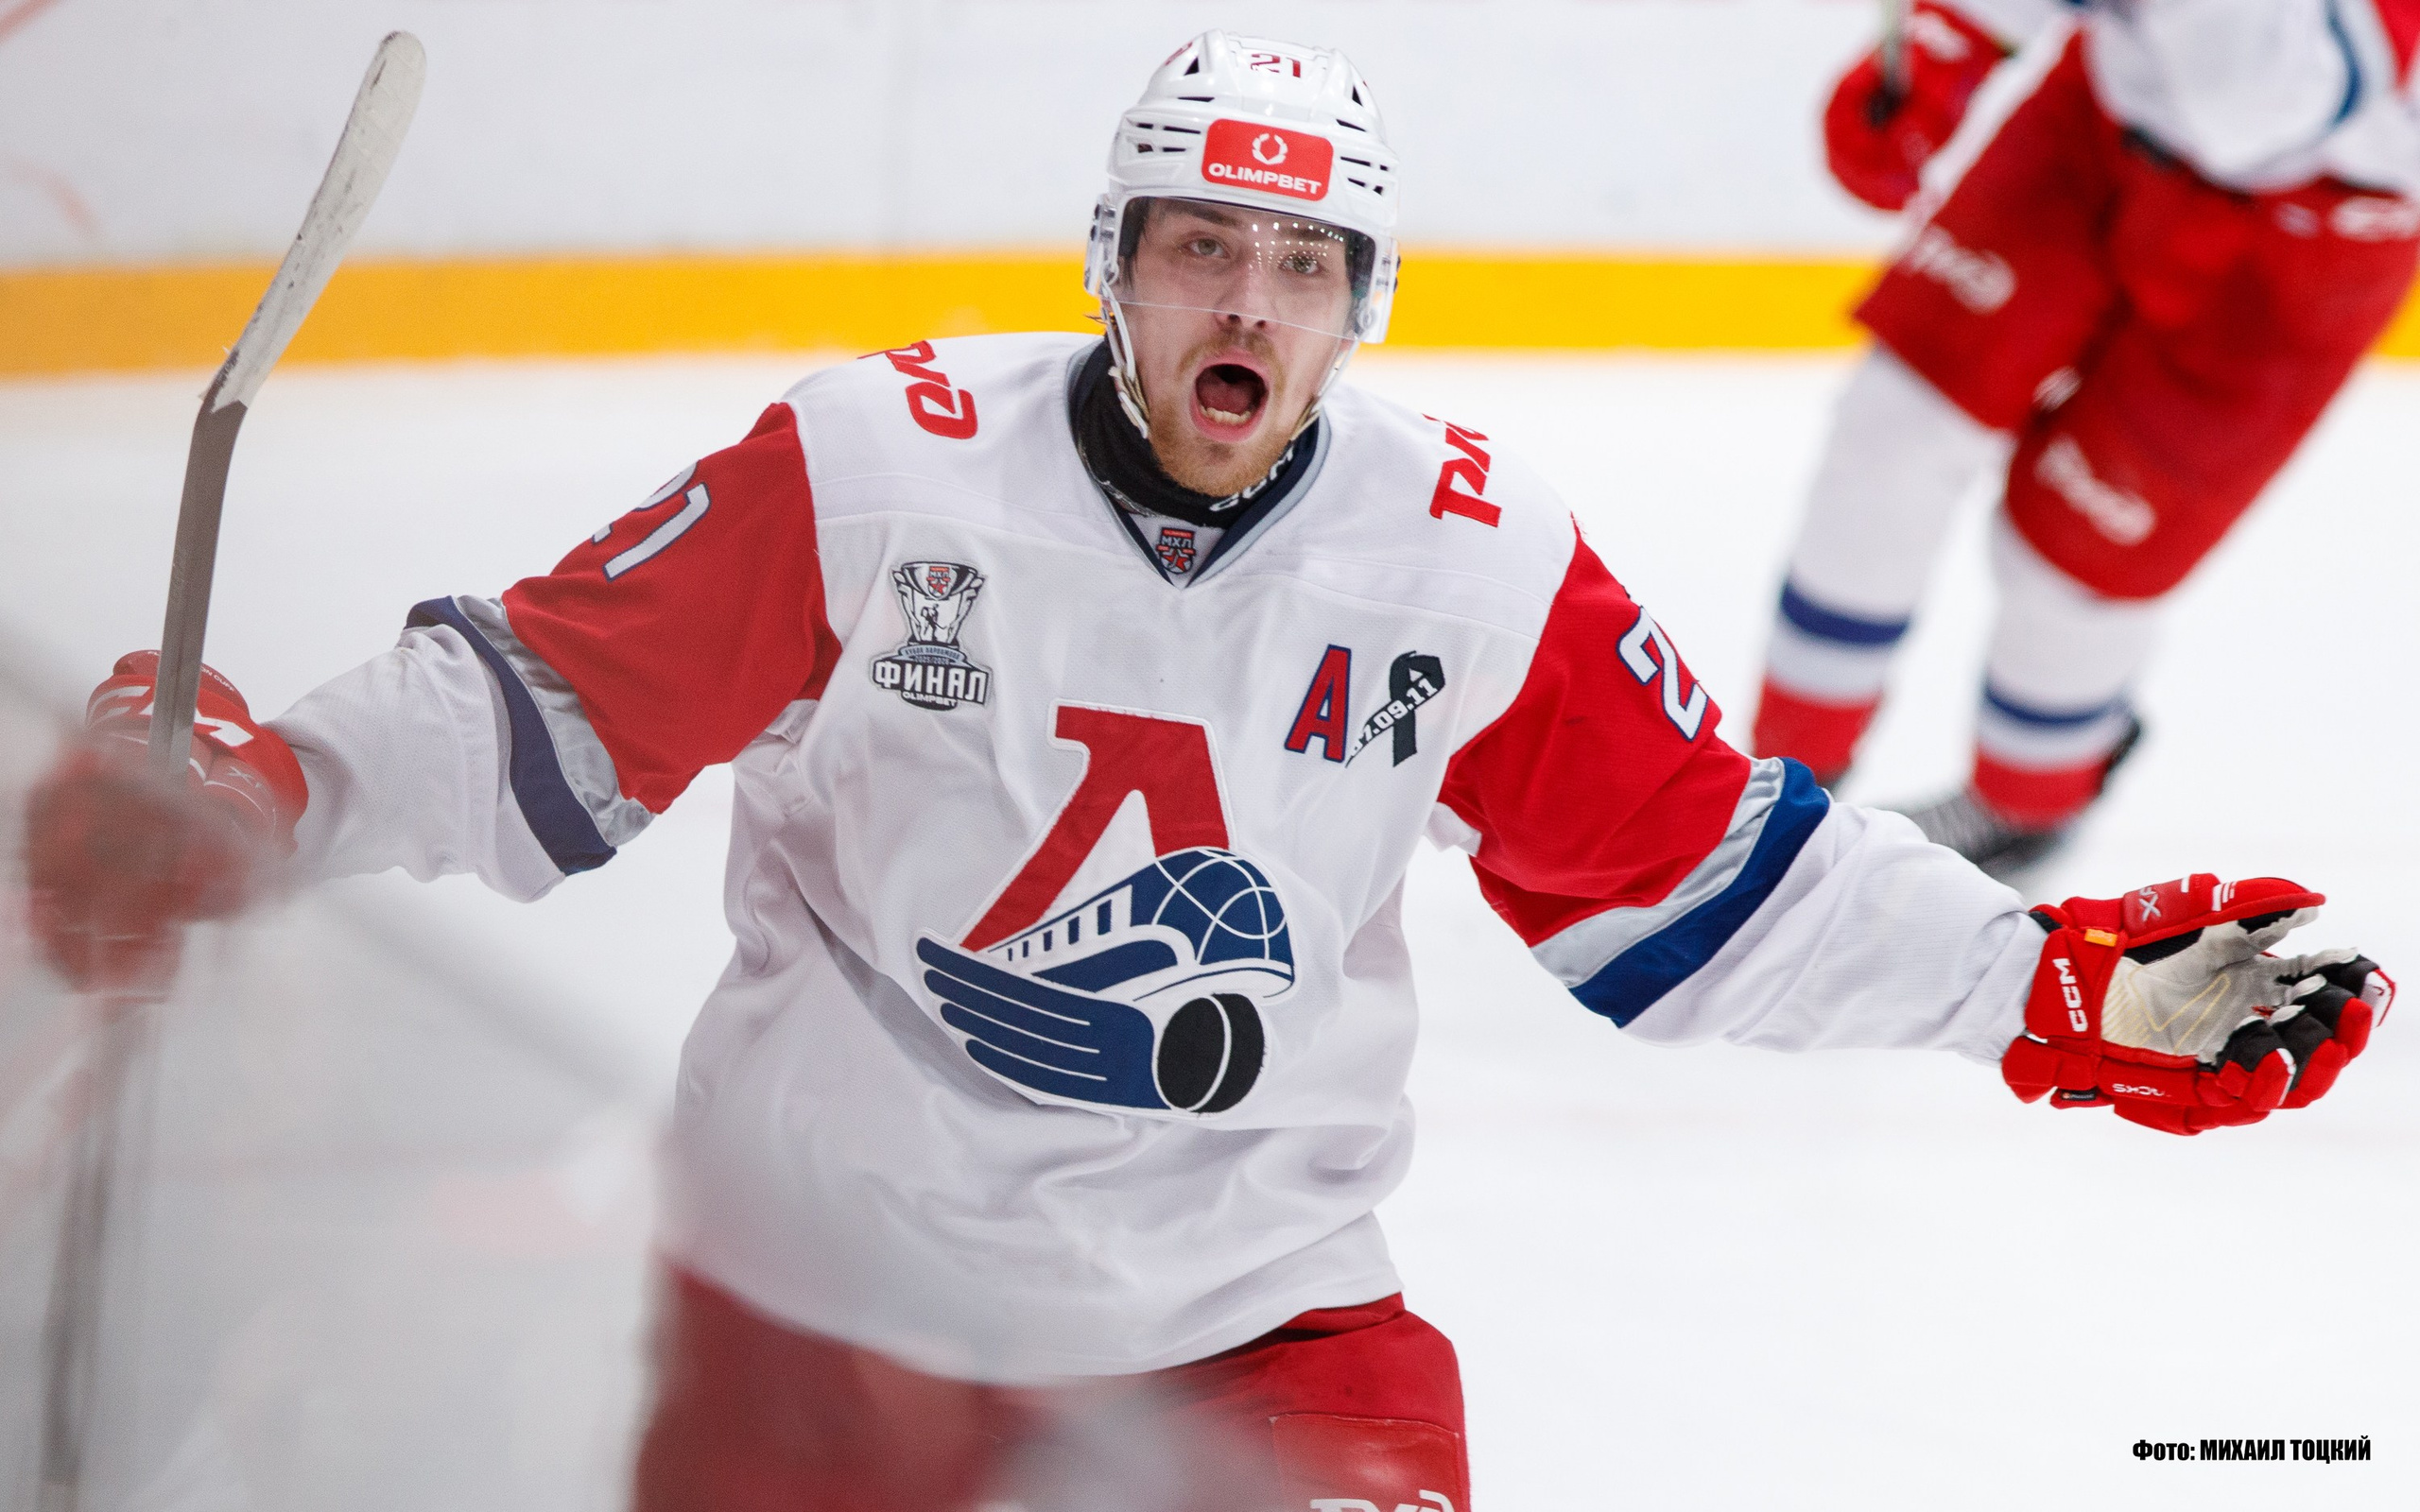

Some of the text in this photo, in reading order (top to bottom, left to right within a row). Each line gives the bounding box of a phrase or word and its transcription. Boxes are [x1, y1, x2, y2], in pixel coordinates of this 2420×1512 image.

[1250, 53, 1302, 78] 21
[1208, 163, 1322, 195] OLIMPBET
[1161, 535, 1193, 549] МХЛ
[874, 661, 988, 703] ФИНАЛ
[902, 691, 957, 707] OLIMPBET
[2051, 957, 2089, 1033] CCM
